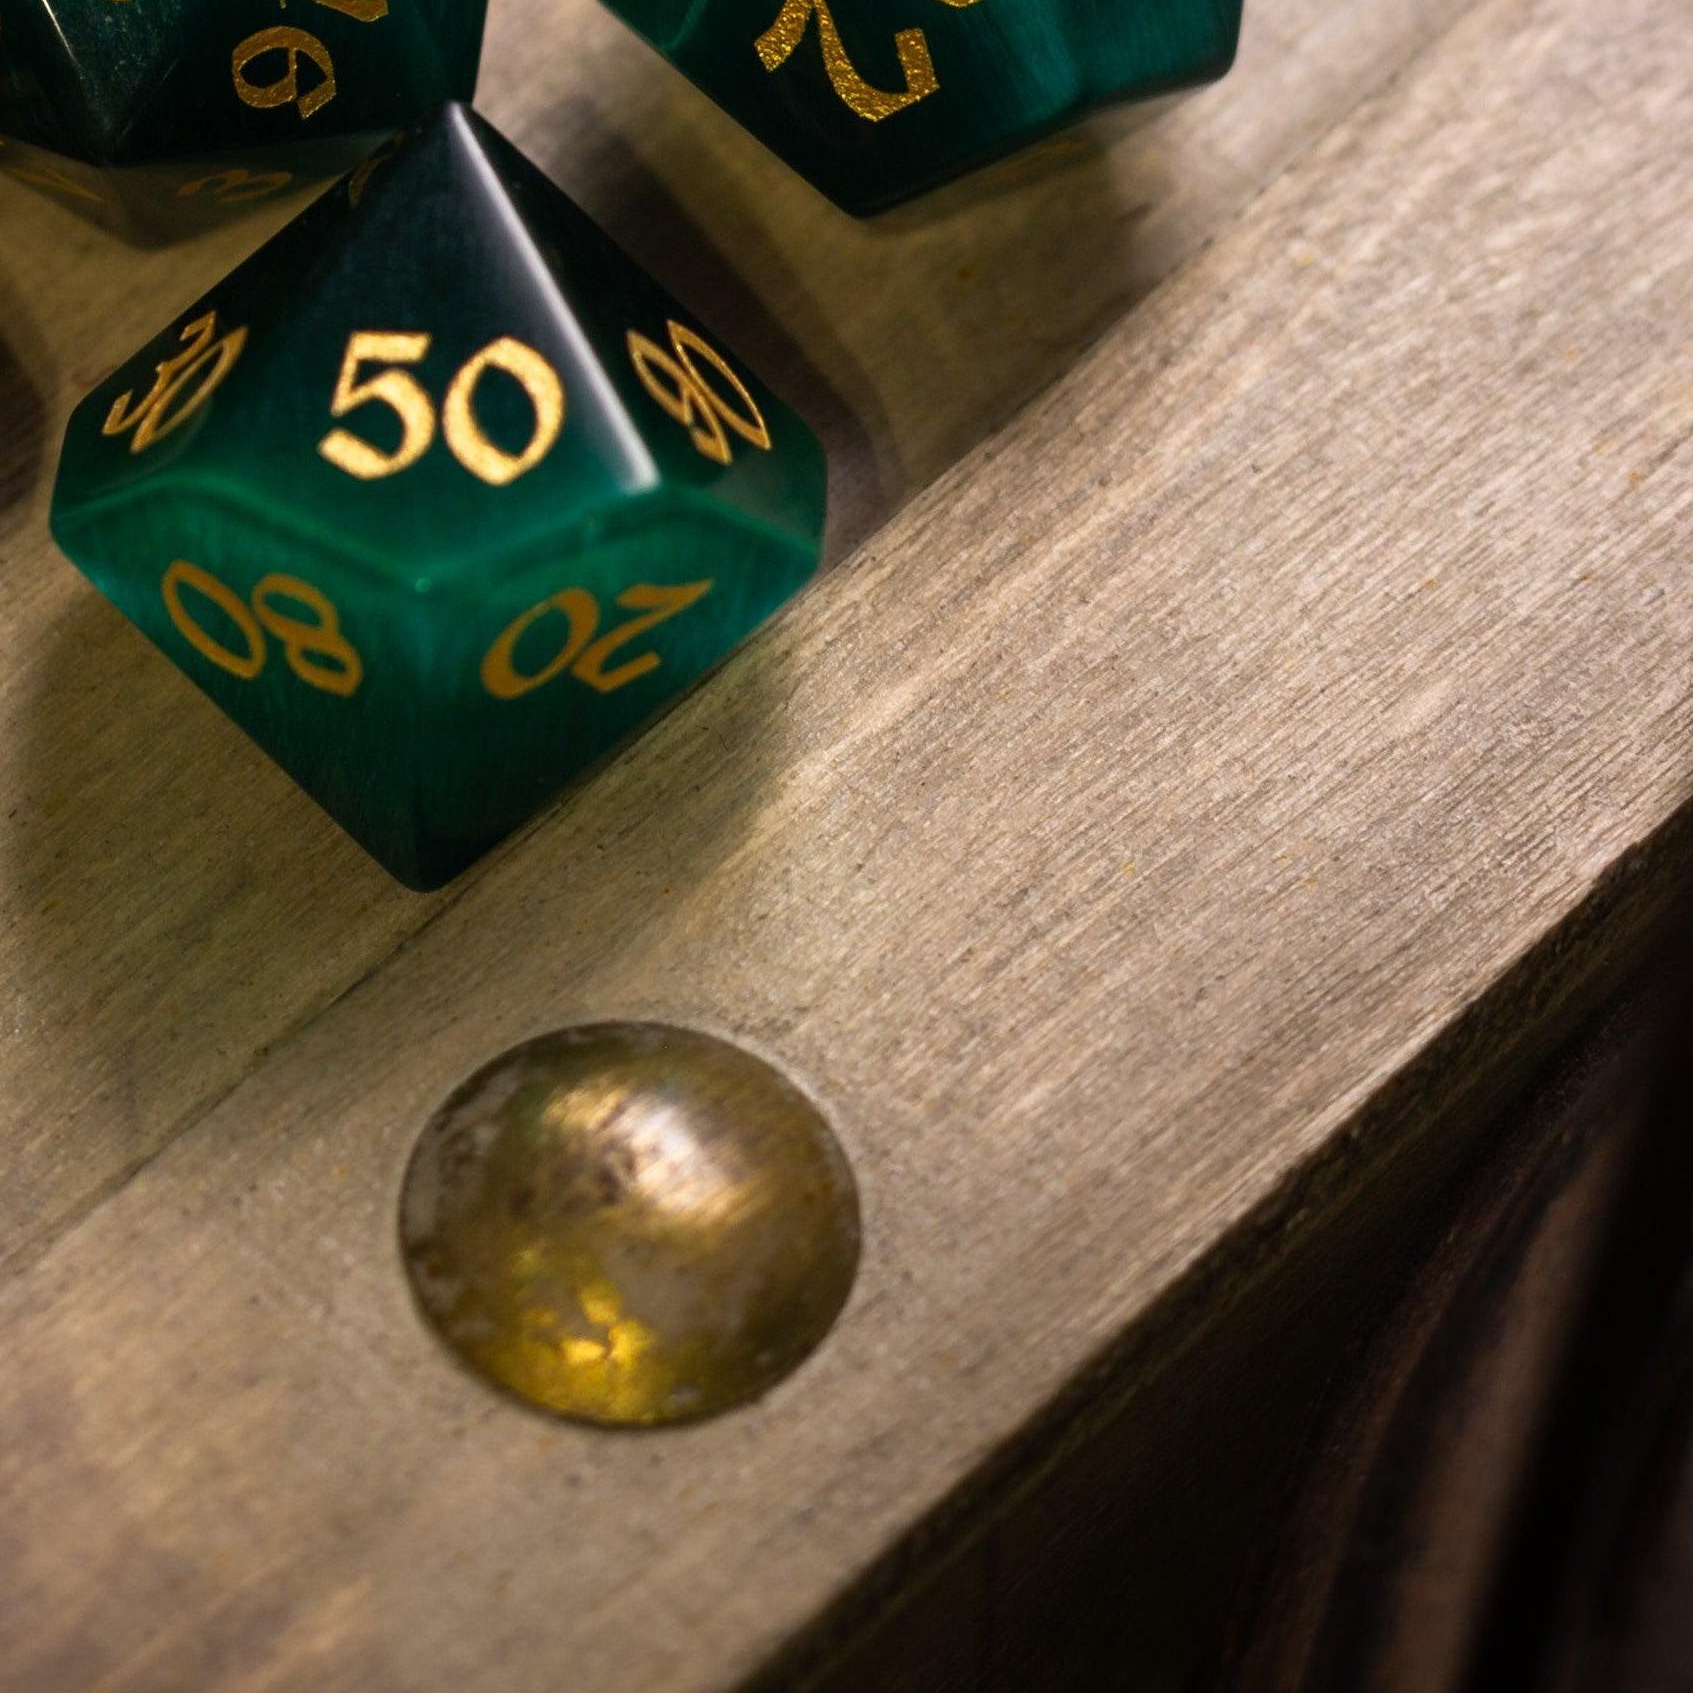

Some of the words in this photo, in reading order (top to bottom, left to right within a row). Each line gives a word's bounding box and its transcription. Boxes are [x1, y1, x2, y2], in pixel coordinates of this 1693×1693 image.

[103, 311, 248, 454] 30
[320, 330, 565, 485] 50
[627, 320, 772, 464] 90
[161, 560, 363, 696] 80
[481, 578, 714, 699] 20
